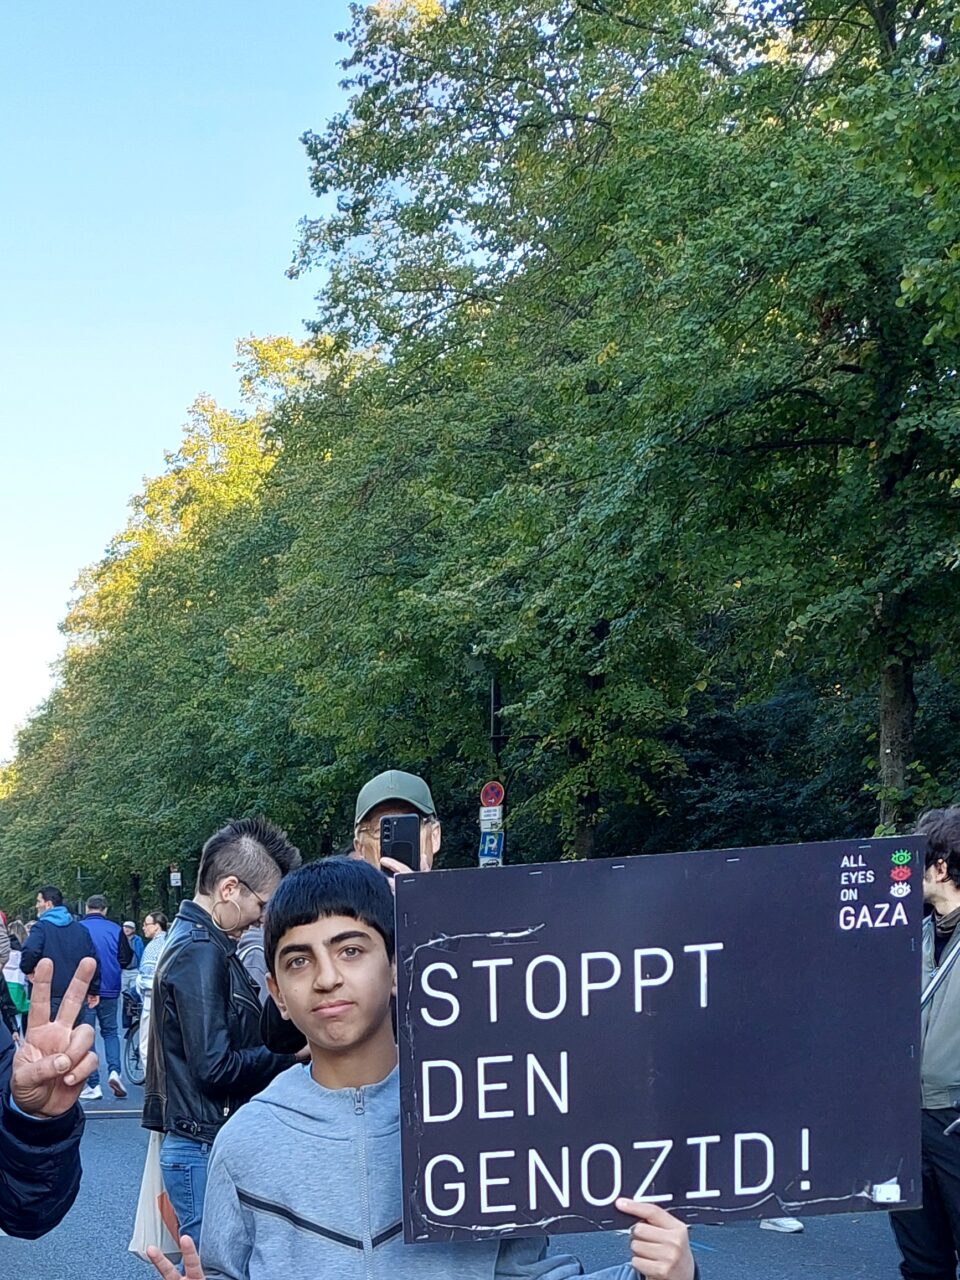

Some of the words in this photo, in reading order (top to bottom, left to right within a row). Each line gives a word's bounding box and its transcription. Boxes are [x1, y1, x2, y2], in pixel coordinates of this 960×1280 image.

[840, 854, 867, 868] ALL
[840, 869, 875, 885] EYES
[840, 888, 858, 901] ON
[839, 902, 909, 930] GAZA
[420, 942, 724, 1027] STOPPT
[421, 1051, 569, 1123] DEN
[424, 1128, 811, 1217] GENOZID!
